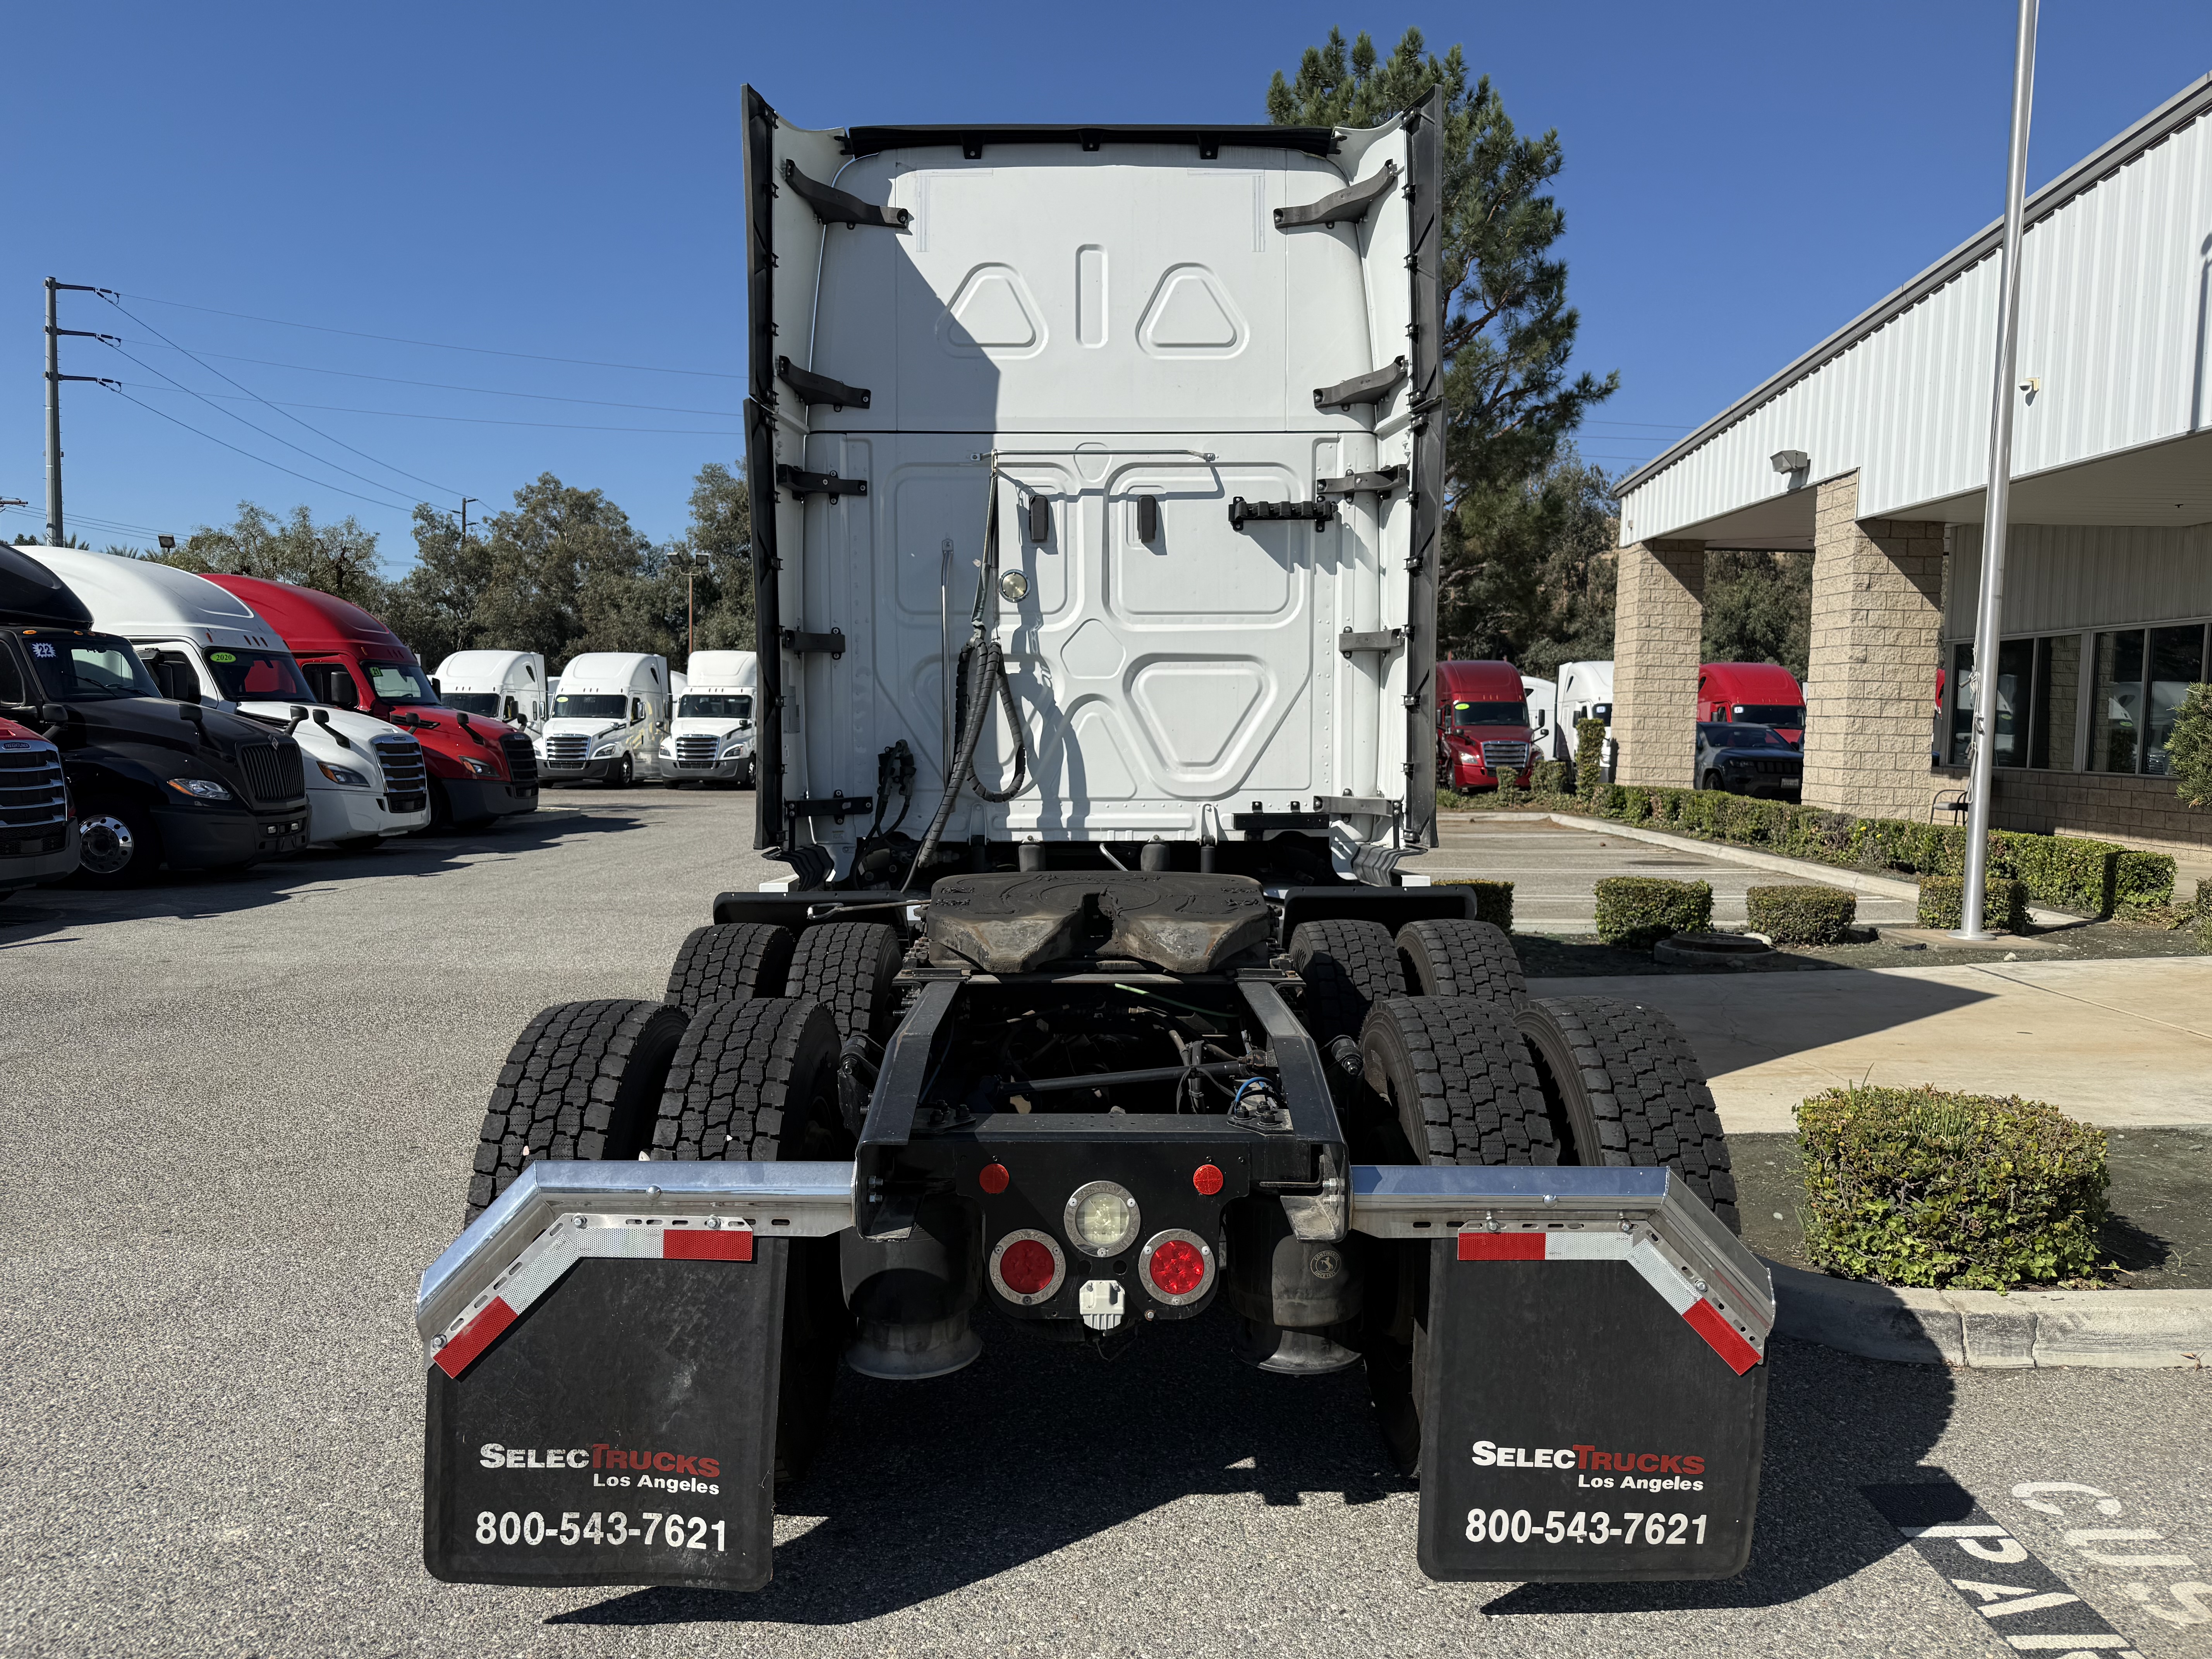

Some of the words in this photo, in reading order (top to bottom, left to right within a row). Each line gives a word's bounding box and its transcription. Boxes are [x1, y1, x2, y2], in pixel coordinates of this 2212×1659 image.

[38, 645, 52, 655] 22
[1314, 1252, 1340, 1261] CONTINENTAL
[593, 1474, 630, 1487] Los
[637, 1475, 720, 1495] Angeles
[1578, 1474, 1614, 1488] Los
[1620, 1476, 1704, 1492] Angeles
[476, 1511, 725, 1552] 800-543-7621
[1465, 1508, 1707, 1545] 800-543-7621
